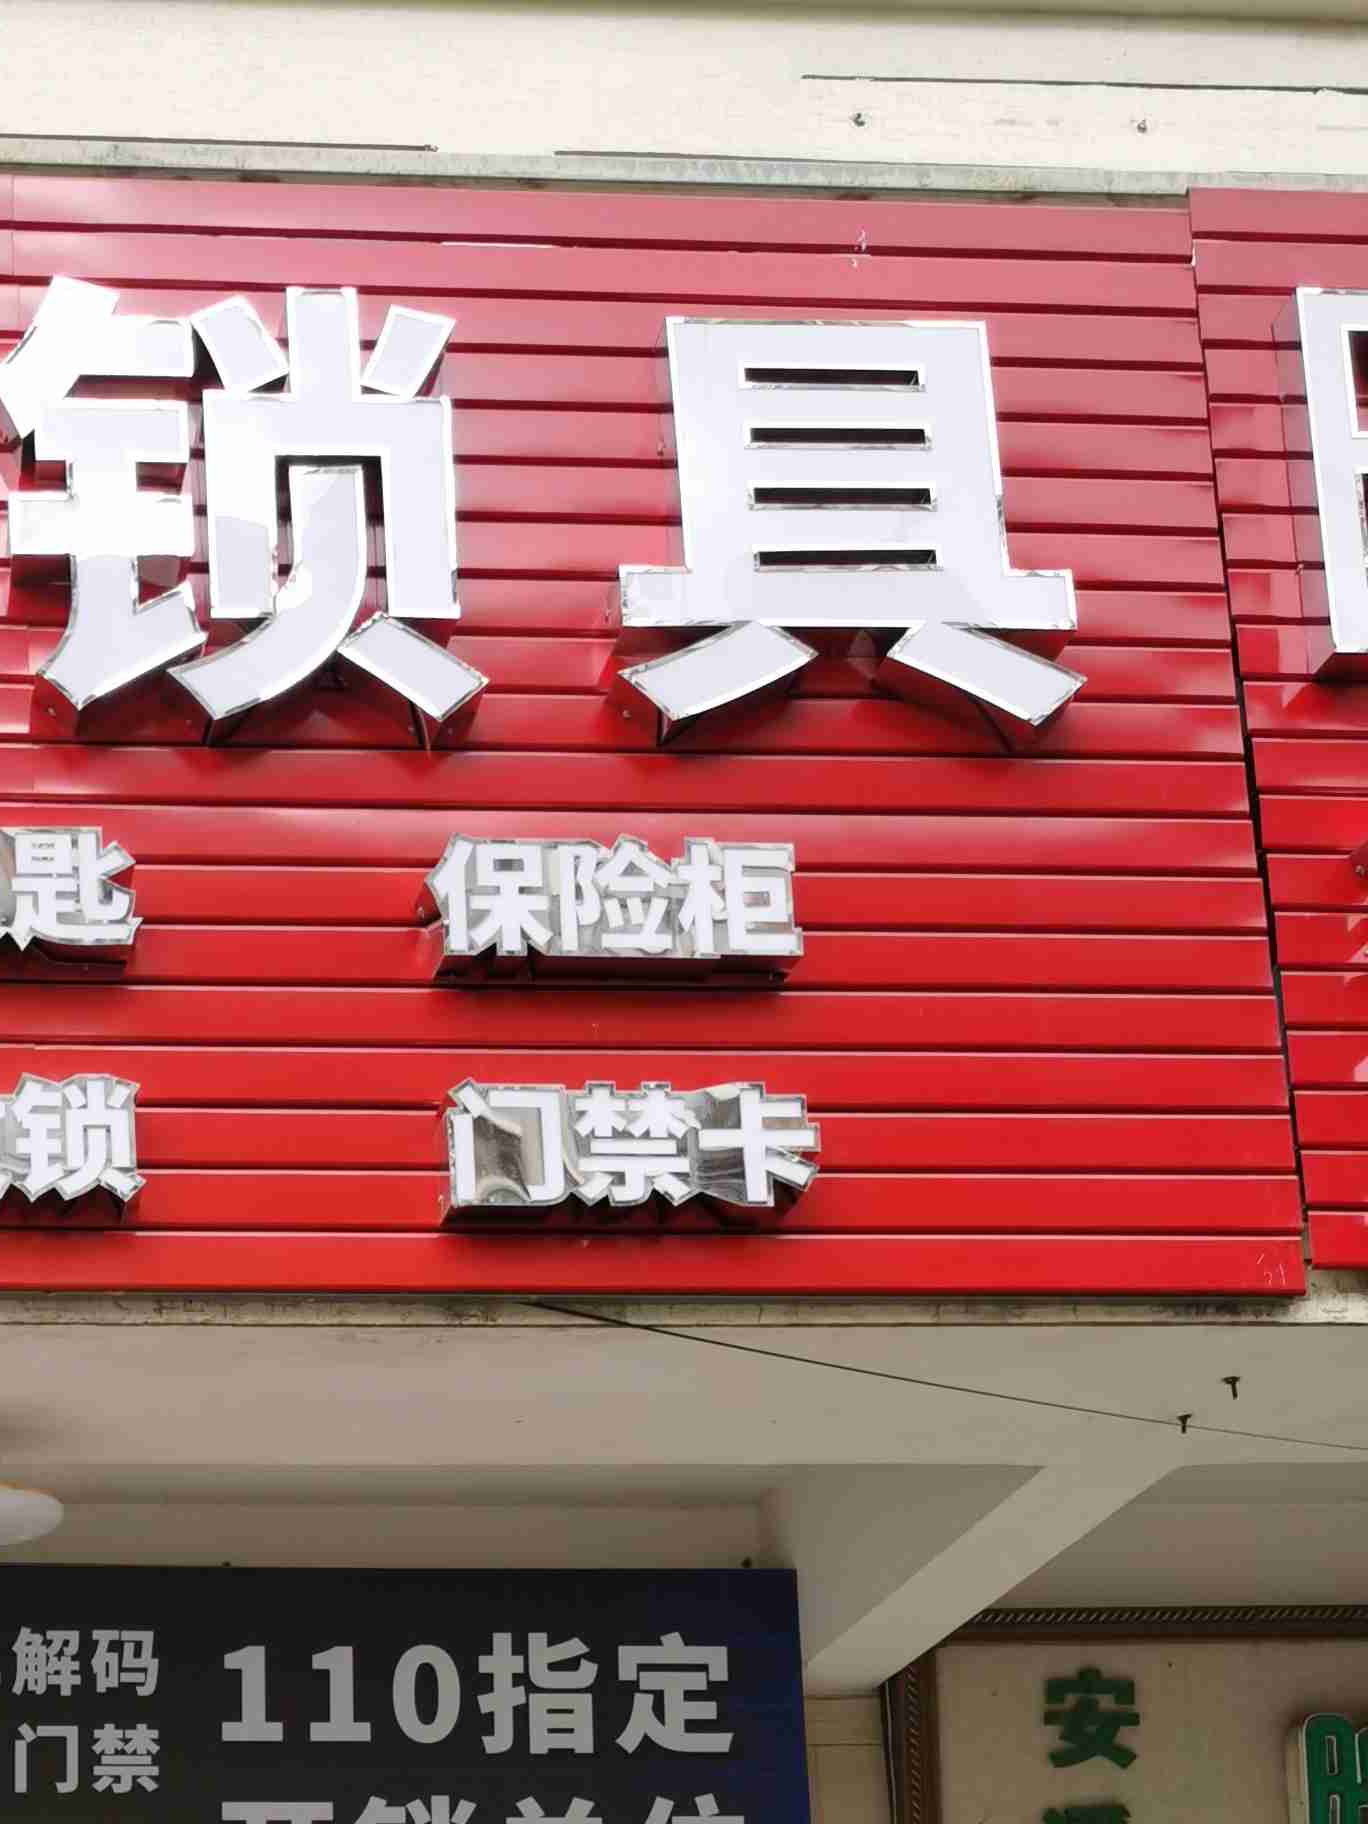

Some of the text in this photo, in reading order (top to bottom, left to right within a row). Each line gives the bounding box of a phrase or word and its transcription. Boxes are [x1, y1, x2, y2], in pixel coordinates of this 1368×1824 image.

[427, 833, 802, 957] 保险柜
[447, 1079, 820, 1208] 门禁卡
[222, 1632, 735, 1754] 110指定
